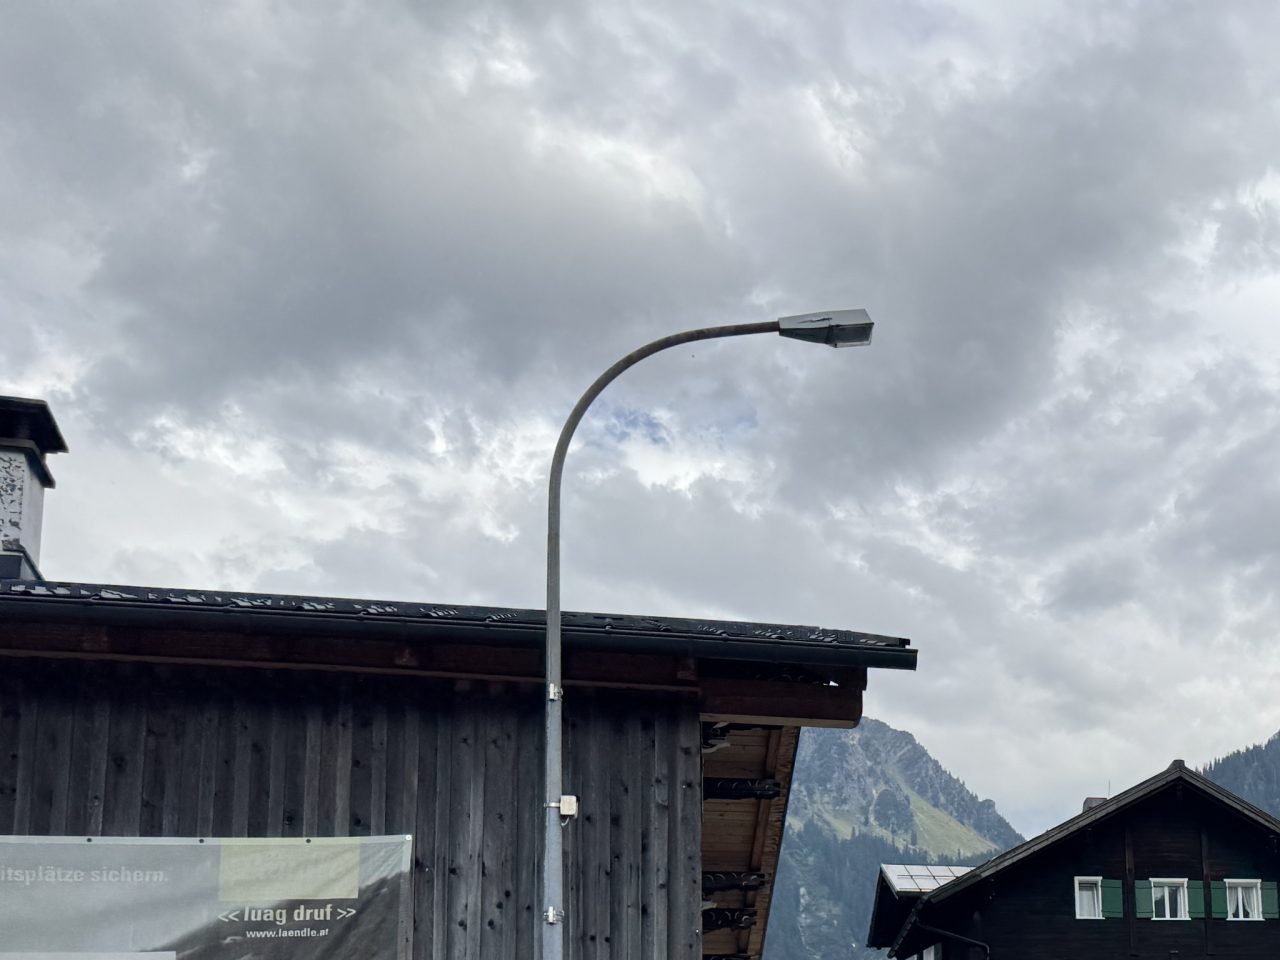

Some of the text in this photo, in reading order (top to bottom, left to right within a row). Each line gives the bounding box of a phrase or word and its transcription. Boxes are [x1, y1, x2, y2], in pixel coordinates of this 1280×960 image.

[90, 866, 169, 882] sichern.
[244, 906, 287, 925] luag
[293, 904, 333, 921] druf
[246, 928, 329, 938] www.laendle.at
